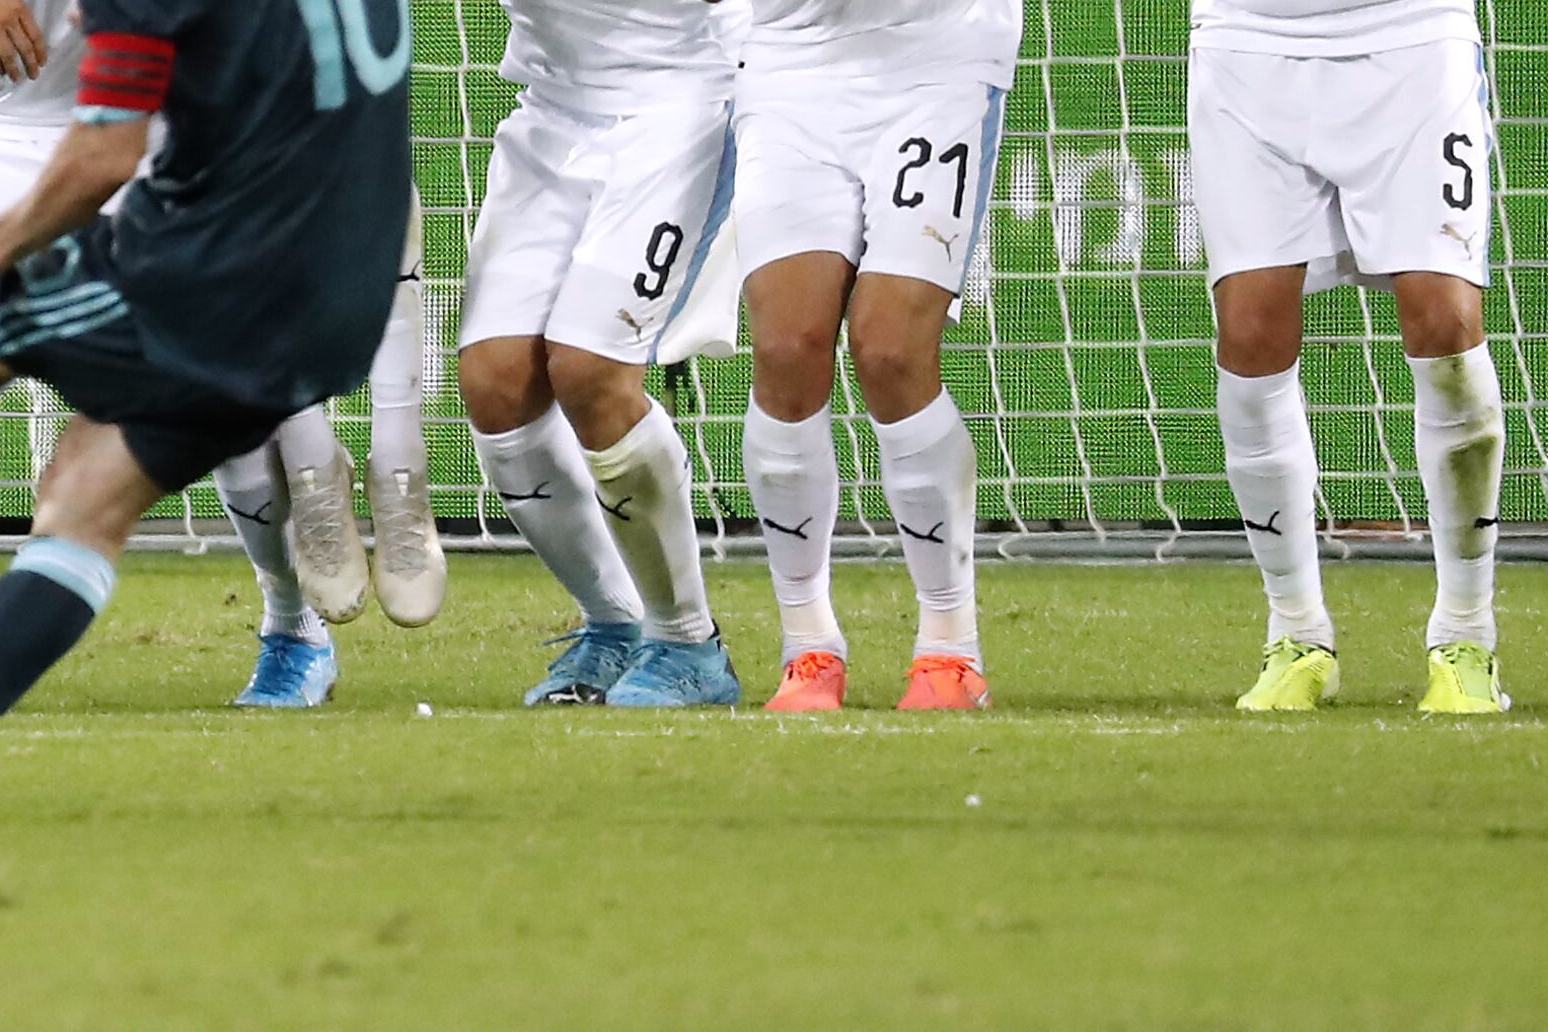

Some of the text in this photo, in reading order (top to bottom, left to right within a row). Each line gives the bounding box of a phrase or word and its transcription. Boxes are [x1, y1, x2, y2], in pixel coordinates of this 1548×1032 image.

[892, 137, 969, 219] 21
[1442, 132, 1473, 211] 5
[633, 221, 684, 301] 9
